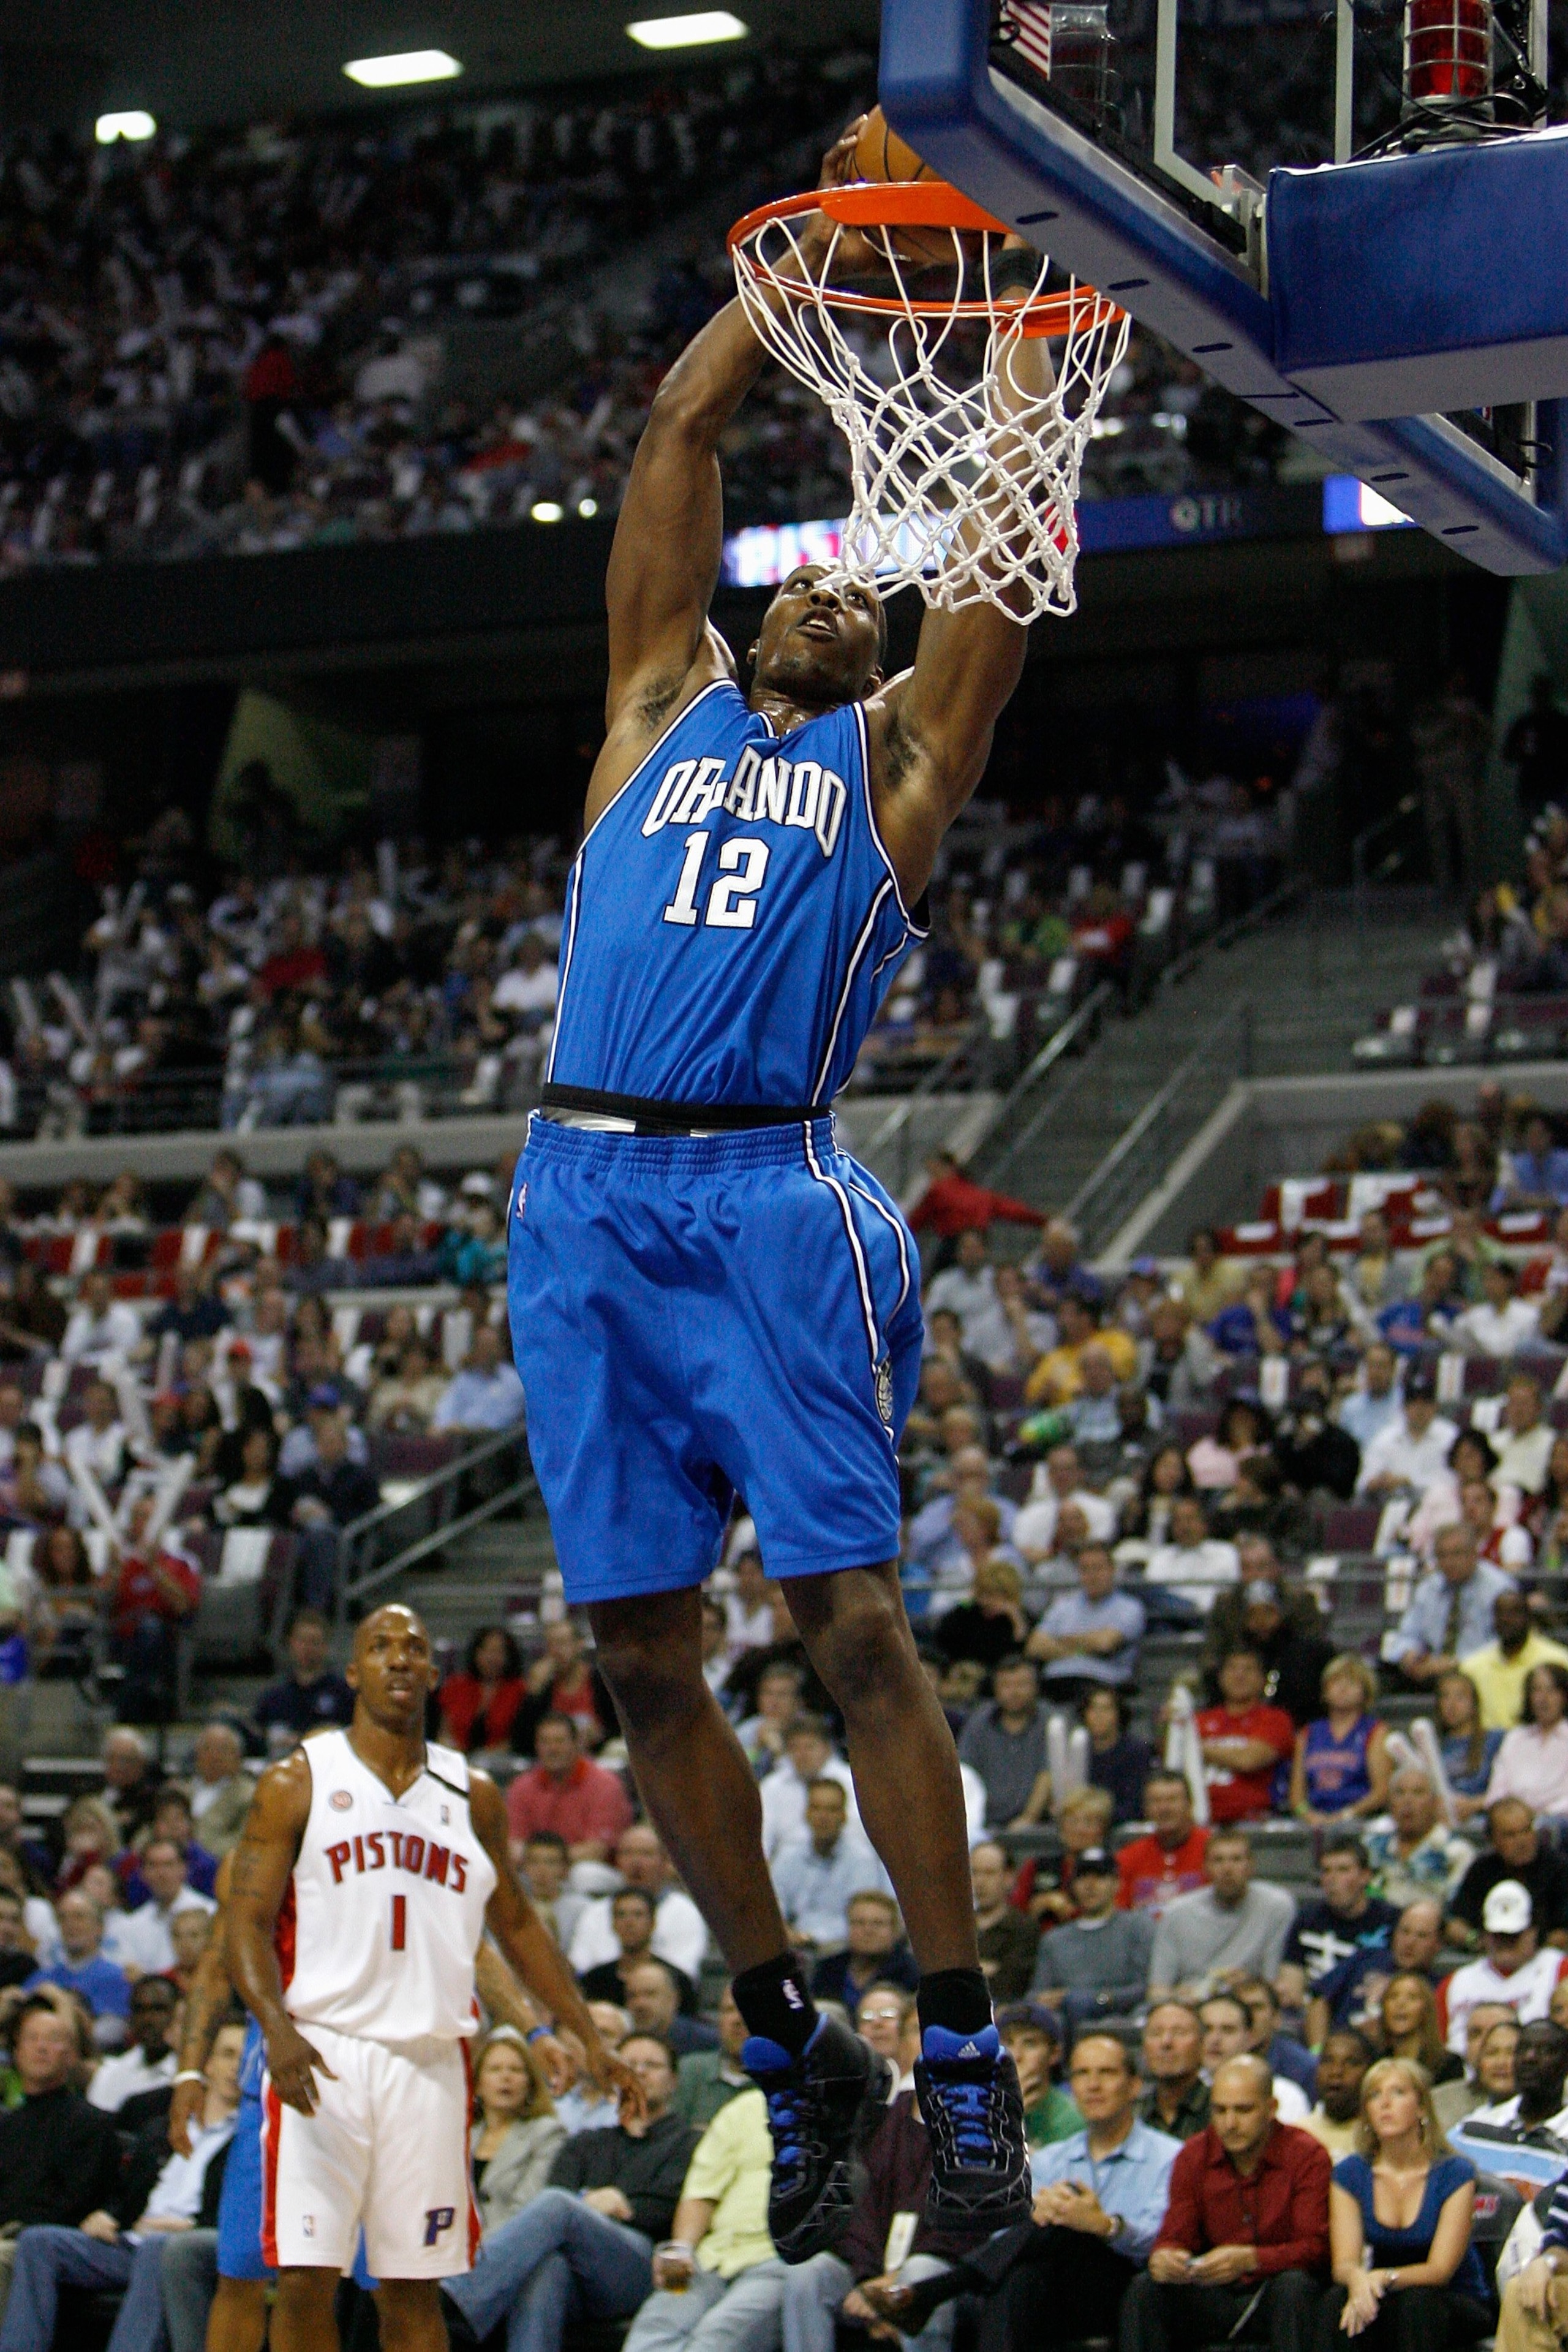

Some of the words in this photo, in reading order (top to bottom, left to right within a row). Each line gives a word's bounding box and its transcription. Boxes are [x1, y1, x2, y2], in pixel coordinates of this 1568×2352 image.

[663, 830, 770, 929] 12
[325, 1831, 469, 1894] PISTONS
[391, 1895, 406, 1951] 1
